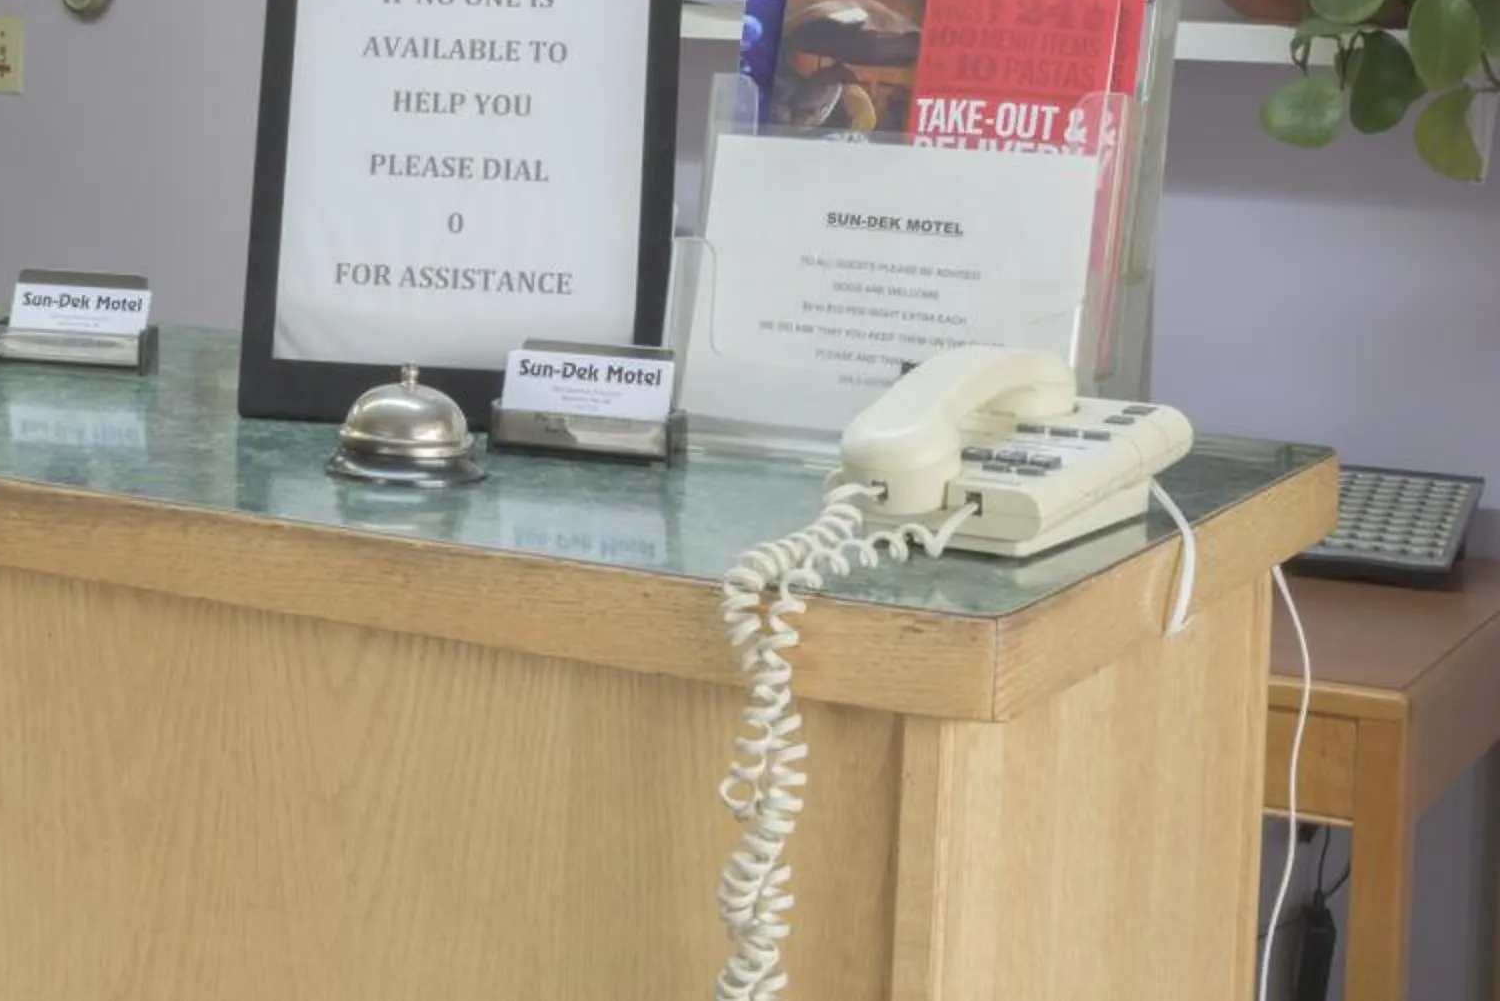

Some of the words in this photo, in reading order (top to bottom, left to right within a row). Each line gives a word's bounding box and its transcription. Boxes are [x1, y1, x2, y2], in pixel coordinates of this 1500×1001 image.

[362, 35, 522, 63] AVAILABLE
[529, 40, 568, 64] TO
[1041, 34, 1101, 59] ITEMS
[1003, 56, 1097, 91] PASTAS
[392, 90, 466, 115] HELP
[474, 93, 533, 117] YOU
[916, 98, 1060, 141] TAKE-OUT
[1064, 108, 1088, 144] &
[369, 154, 474, 180] PLEASE
[481, 158, 550, 183] DIAL
[826, 211, 902, 231] SUN-DEK
[906, 217, 964, 236] MOTEL
[334, 262, 392, 287] FOR
[399, 266, 574, 296] ASSISTANCE
[22, 290, 92, 310] Sun-Dek
[95, 294, 143, 312] Motel
[519, 359, 599, 382] Sun-Dek
[605, 365, 662, 387] Motel
